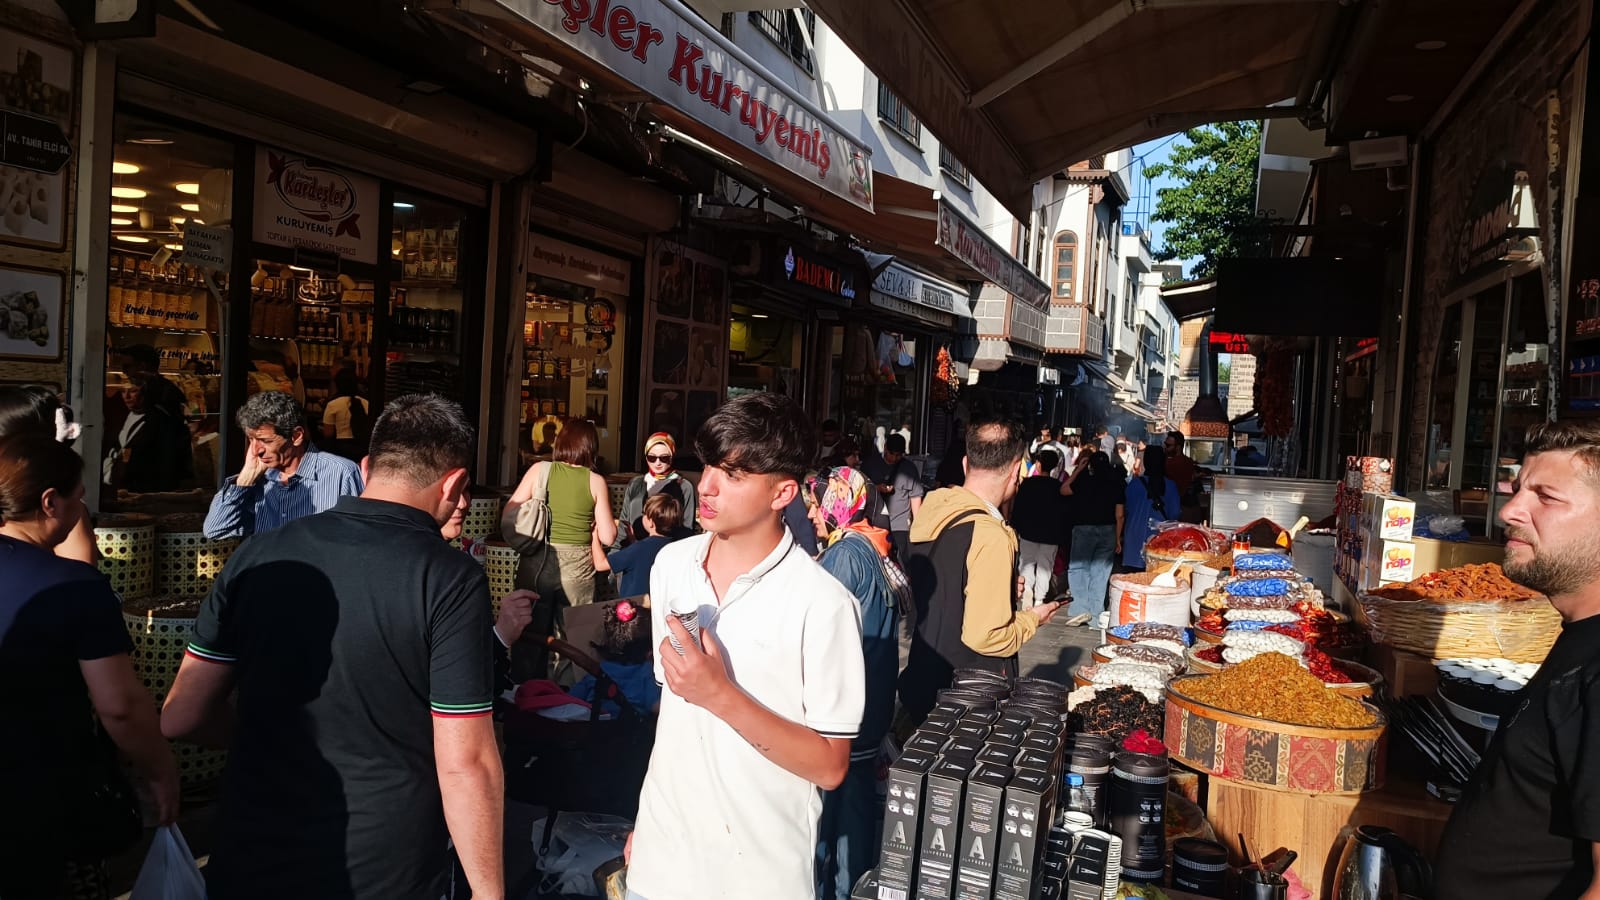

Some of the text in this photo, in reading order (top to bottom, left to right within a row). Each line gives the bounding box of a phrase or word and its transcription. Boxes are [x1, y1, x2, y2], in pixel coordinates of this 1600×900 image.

[543, 0, 664, 64] şler
[667, 32, 831, 178] Kuruyemiş
[7, 131, 20, 144] AV.
[276, 215, 334, 237] KURUYEMİŞ
[125, 304, 145, 314] Kredi
